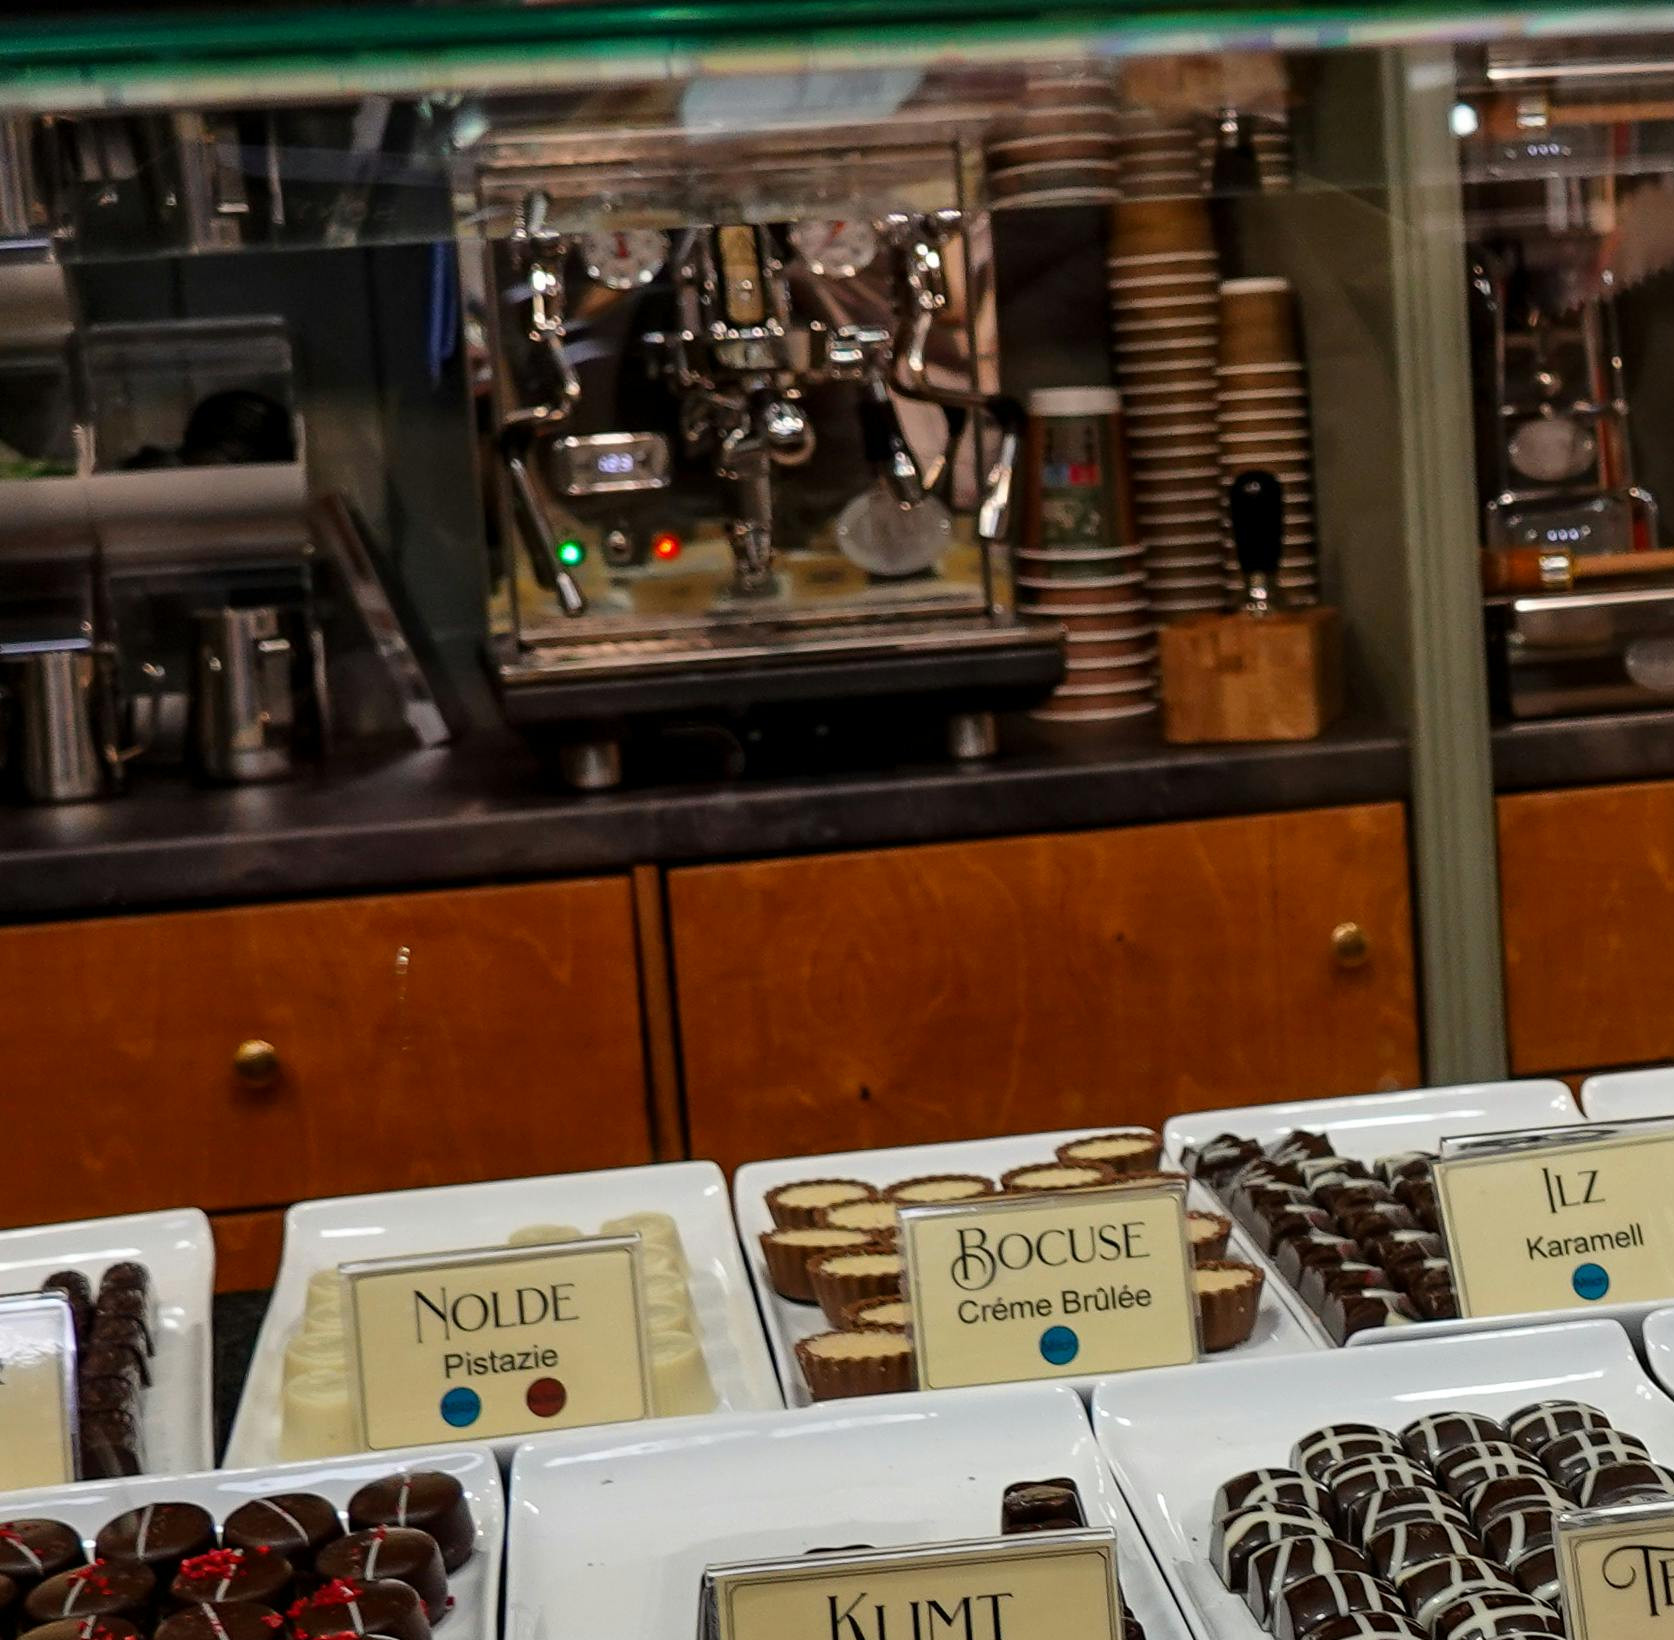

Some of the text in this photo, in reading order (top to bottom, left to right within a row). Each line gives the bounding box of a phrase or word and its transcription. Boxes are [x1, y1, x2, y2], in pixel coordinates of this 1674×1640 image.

[1541, 1165, 1607, 1216] ILZ
[950, 1219, 1152, 1292] BOCUSE
[1525, 1223, 1646, 1261] Karamell
[414, 1282, 580, 1343] NOLDE
[1062, 1284, 1153, 1316] Brûlée
[443, 1345, 560, 1380] Pistazie
